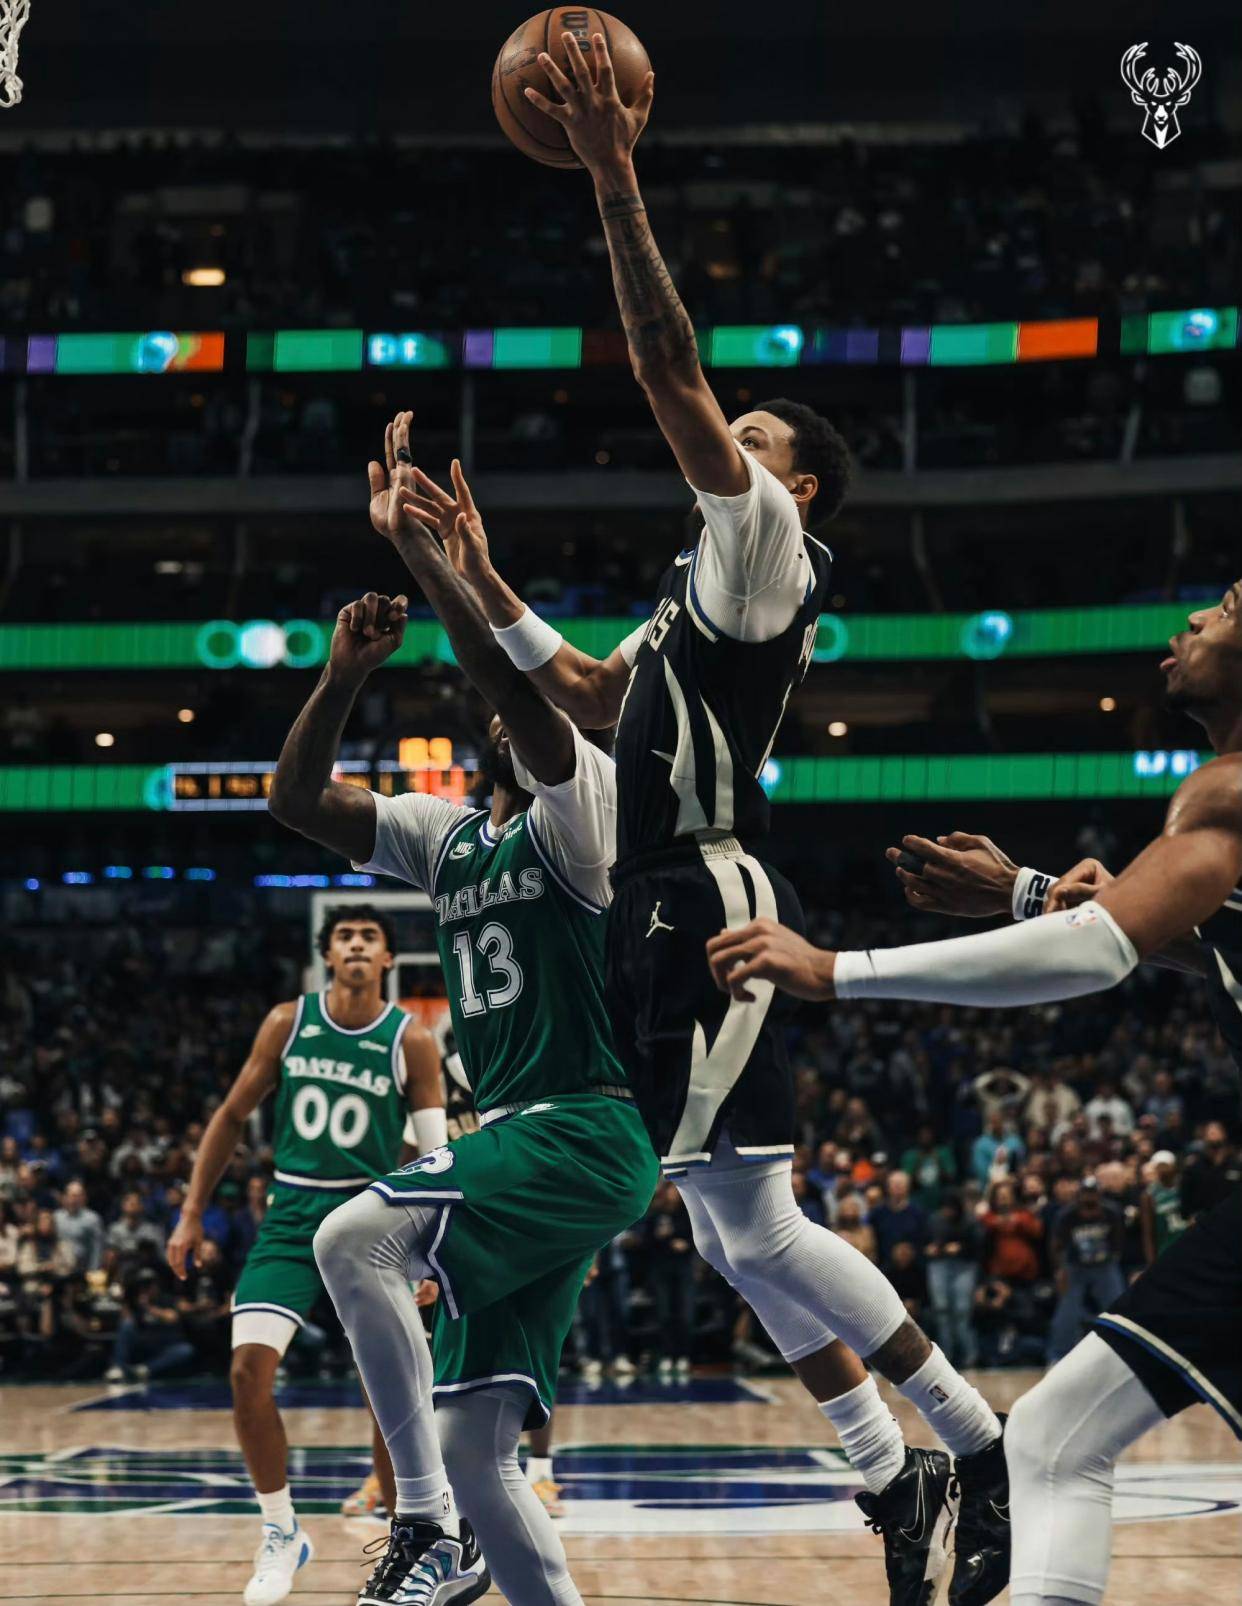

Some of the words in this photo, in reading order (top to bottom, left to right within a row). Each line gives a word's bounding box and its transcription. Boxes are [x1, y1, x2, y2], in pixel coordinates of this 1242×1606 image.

[454, 841, 475, 854] NIKE
[434, 868, 545, 926] DALLAS
[453, 921, 524, 1018] 13
[284, 1056, 392, 1097] DALLAS
[292, 1084, 370, 1149] 00
